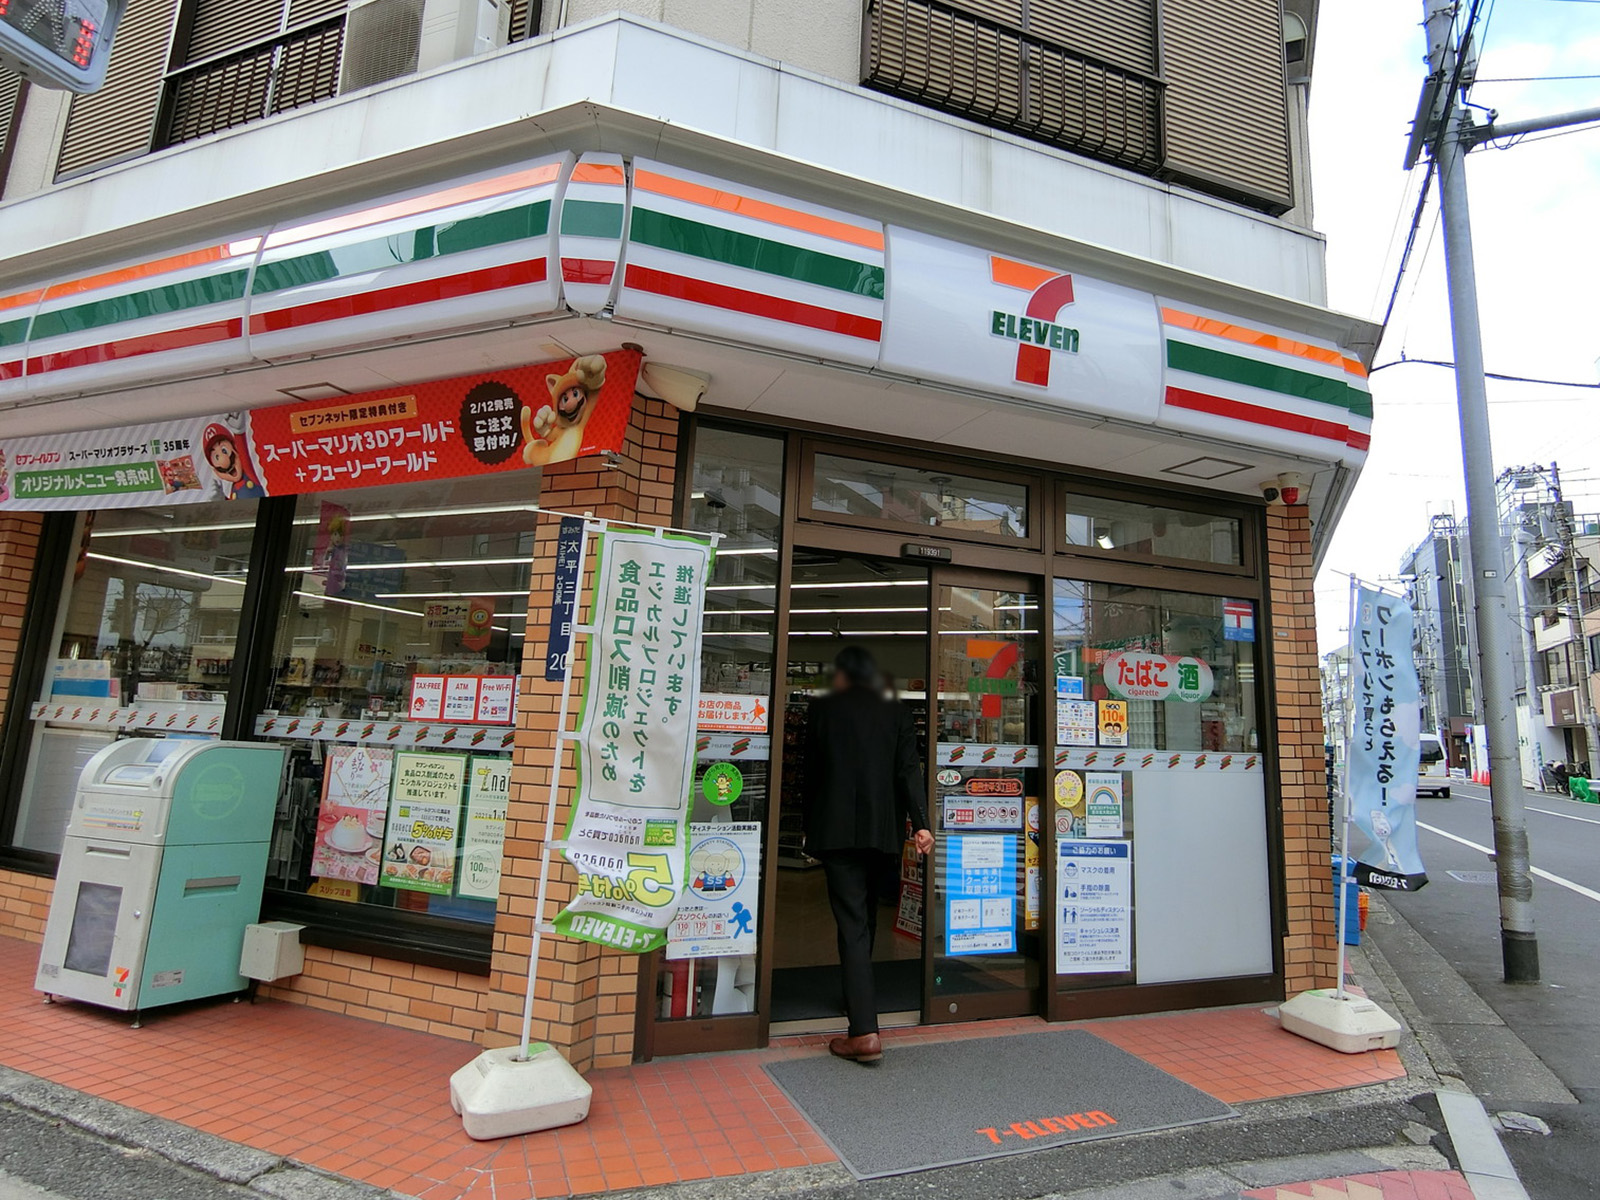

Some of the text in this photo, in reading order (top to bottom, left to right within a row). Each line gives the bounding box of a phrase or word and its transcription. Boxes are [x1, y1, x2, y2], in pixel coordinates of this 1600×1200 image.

[470, 397, 514, 415] 2/12発売
[475, 415, 513, 434] ご注文
[69, 443, 149, 461] スーパーマリオブラザーズ
[163, 439, 191, 452] 35周年
[263, 420, 455, 462] スーパーマリオ3Dワールド
[558, 541, 567, 567] TAIHEI
[560, 540, 580, 636] 太平三丁目
[1117, 658, 1169, 688] たばこ
[1178, 662, 1199, 691] 酒
[416, 682, 442, 690] TAX-FREE
[1128, 688, 1160, 697] cigarette
[1180, 691, 1200, 699] liquor
[698, 700, 742, 710] お店の商品
[491, 774, 511, 792] na
[411, 820, 455, 841] 5%付与
[1072, 847, 1117, 855] ご協力のお願い
[1081, 866, 1116, 875] マスクの着用
[1080, 884, 1111, 892] 手指の除菌
[695, 921, 707, 929] 119
